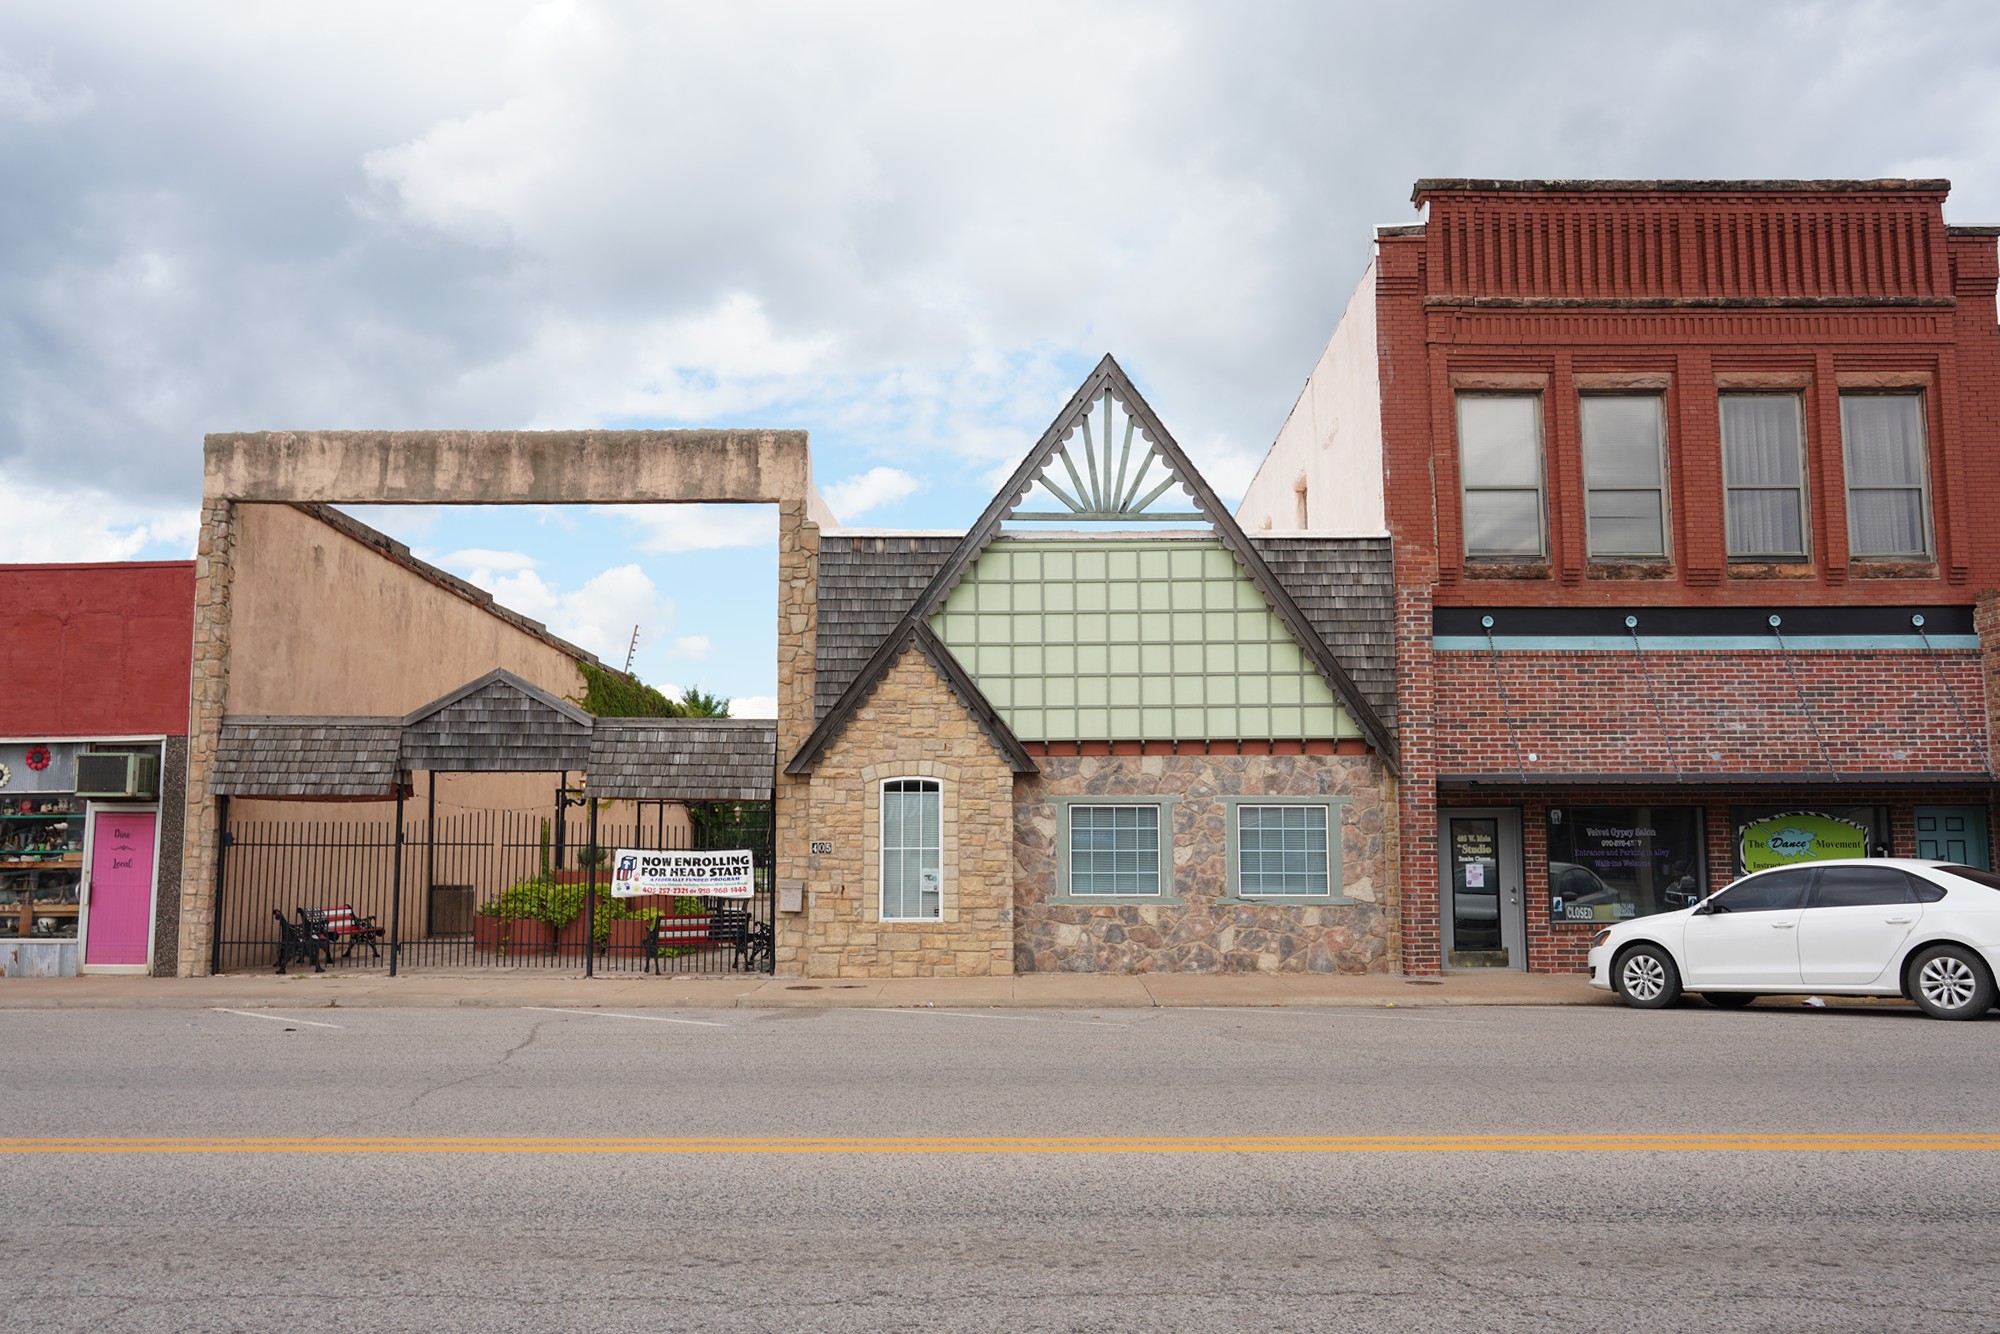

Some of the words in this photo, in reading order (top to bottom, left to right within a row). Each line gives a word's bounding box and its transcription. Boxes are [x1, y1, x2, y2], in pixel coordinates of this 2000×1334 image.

[1586, 828, 1610, 837] Velvet
[1610, 828, 1634, 840] Gypsy
[1635, 828, 1656, 837] Salon
[812, 842, 832, 854] 405
[1748, 840, 1765, 849] The
[1771, 837, 1806, 849] Dance
[1816, 840, 1861, 849] Movement
[1462, 844, 1492, 854] Studio
[1574, 848, 1605, 857] Entrance
[1606, 848, 1618, 857] and
[1620, 848, 1645, 859] Parking
[1654, 848, 1670, 859] alley
[113, 858, 132, 869] Local
[642, 857, 672, 867] NOW
[675, 855, 750, 867] ENROLLING
[1594, 859, 1622, 867] Walk-ins
[1623, 859, 1651, 867] Welcome
[641, 867, 666, 877] FOR
[670, 867, 706, 877] HEAD
[709, 866, 749, 877] START
[1566, 906, 1593, 919] CLOSED
